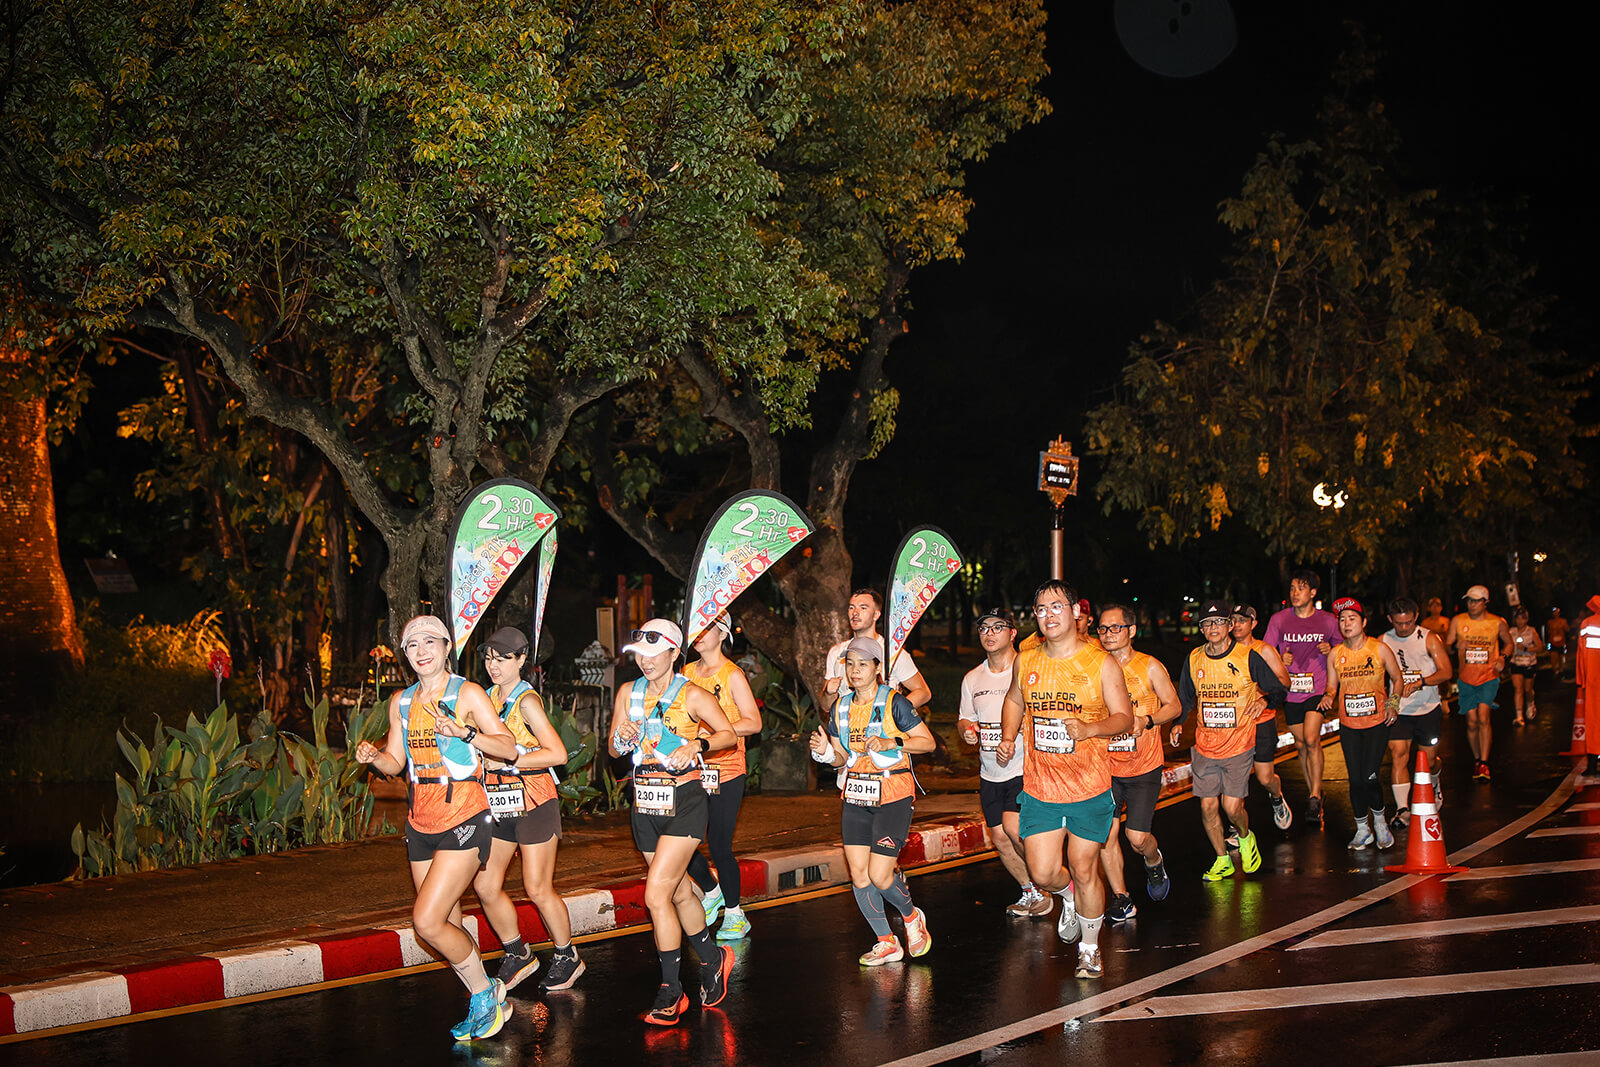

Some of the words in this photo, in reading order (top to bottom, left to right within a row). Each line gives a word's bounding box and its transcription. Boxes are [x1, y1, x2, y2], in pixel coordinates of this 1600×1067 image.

[505, 515, 532, 531] Hr.
[758, 524, 785, 543] Hr.
[453, 558, 487, 601] Pacer
[480, 533, 508, 563] 21K
[483, 573, 503, 591] &
[495, 537, 526, 576] JOY
[696, 562, 733, 600] Pacer
[730, 541, 758, 568] 21K
[727, 578, 747, 594] &
[742, 547, 774, 582] JOY
[927, 557, 946, 574] Hr.
[908, 606, 921, 620] &
[917, 577, 939, 609] JOY
[1283, 633, 1325, 643] ALLMOVE
[1340, 670, 1375, 678] FREEDOM
[1031, 691, 1053, 701] RUN
[1056, 692, 1076, 701] FOR
[1026, 700, 1082, 713] FREEDOM
[423, 728, 436, 737] FO
[848, 783, 863, 793] 2.30
[865, 785, 877, 794] Hr
[508, 795, 520, 805] Hr
[637, 790, 654, 801] 2.30
[657, 791, 671, 802] Hr
